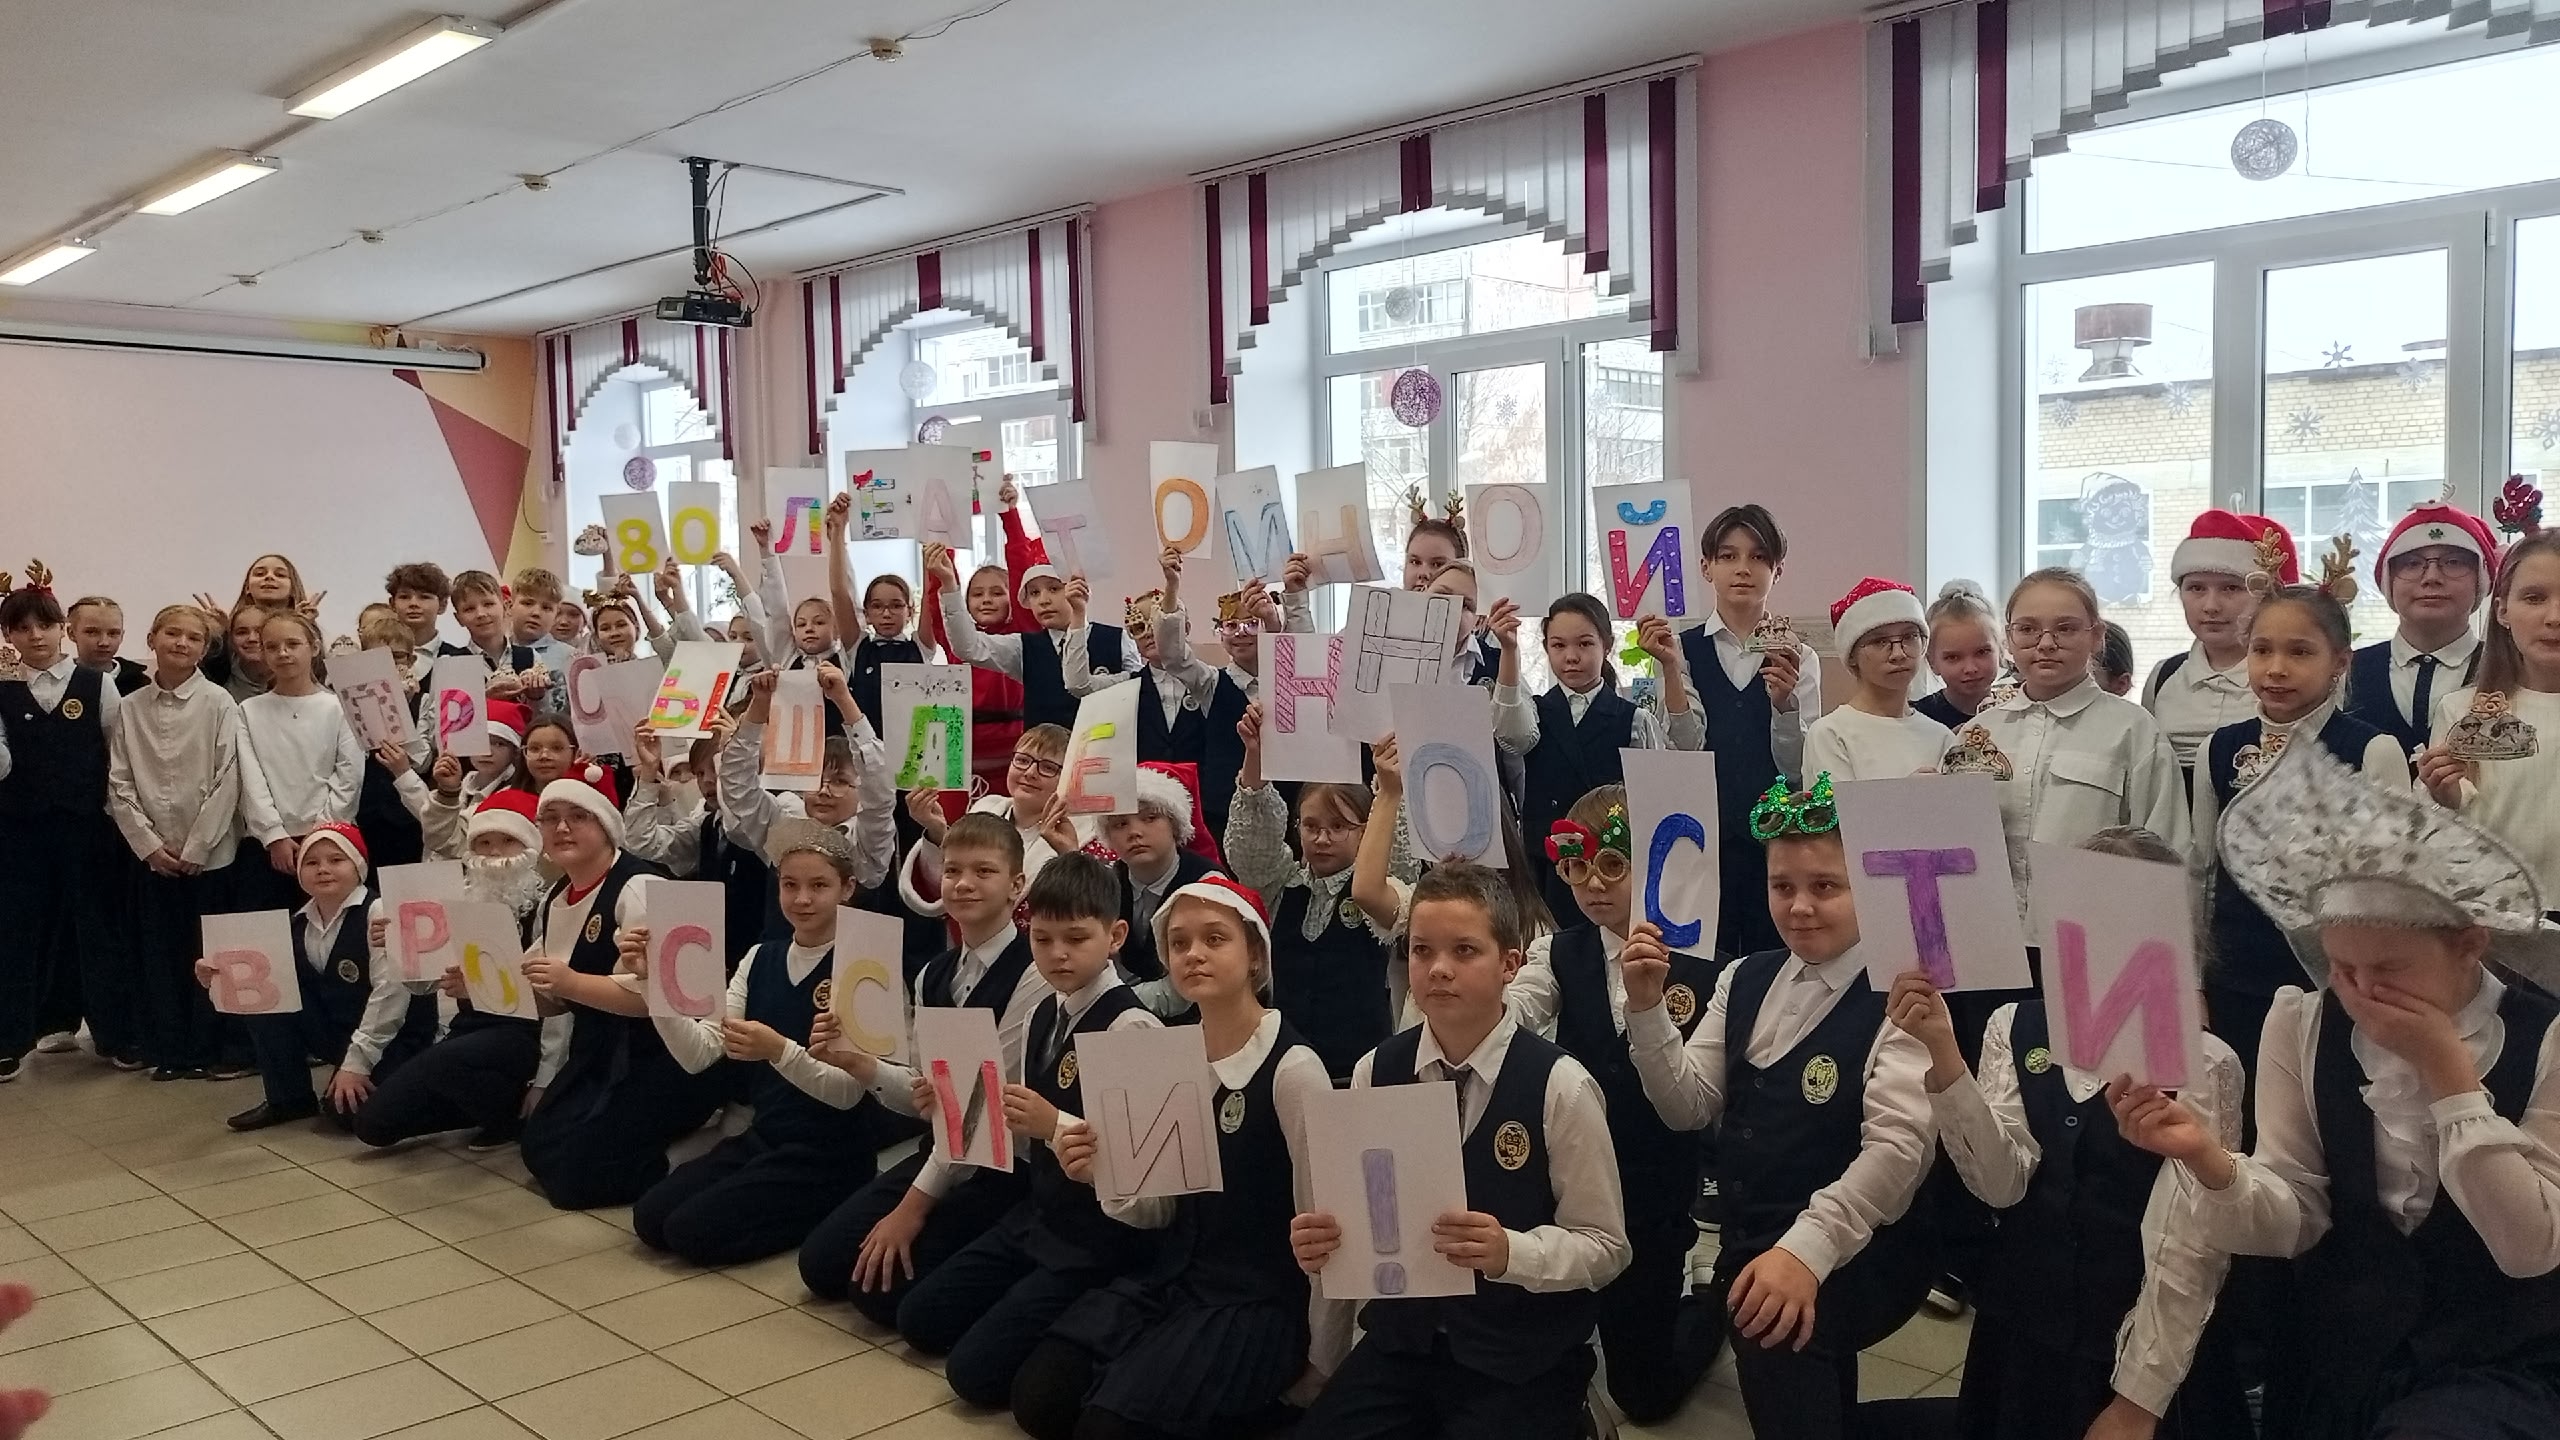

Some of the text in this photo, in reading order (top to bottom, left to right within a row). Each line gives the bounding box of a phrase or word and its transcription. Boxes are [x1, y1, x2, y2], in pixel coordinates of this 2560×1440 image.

[775, 497, 821, 554] Л
[1609, 500, 1686, 618] Й
[439, 689, 474, 752] Р
[650, 668, 730, 732] Ы
[764, 705, 825, 775] Ш
[400, 901, 450, 982] Р
[1862, 848, 1977, 990] Т
[213, 949, 281, 1012] В
[2057, 920, 2188, 1088] И
[931, 1059, 1006, 1168] И
[1102, 1081, 1210, 1196] И
